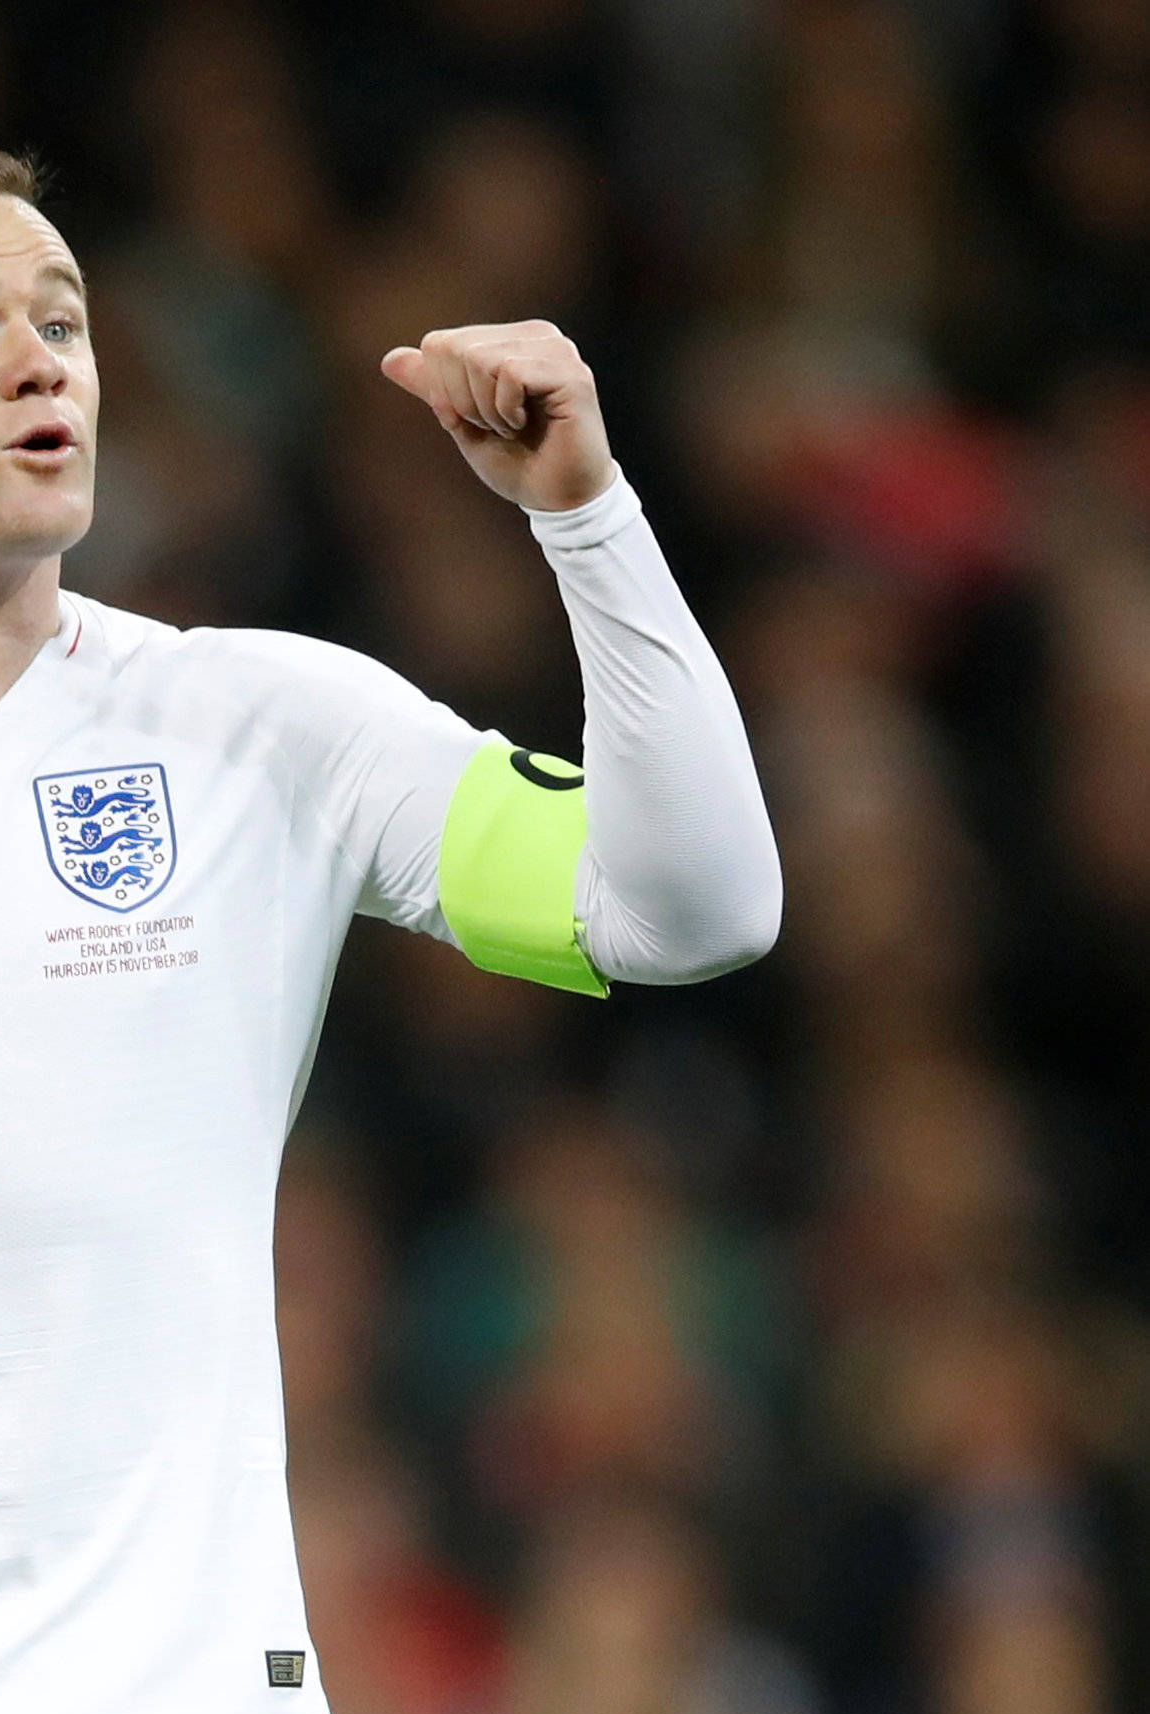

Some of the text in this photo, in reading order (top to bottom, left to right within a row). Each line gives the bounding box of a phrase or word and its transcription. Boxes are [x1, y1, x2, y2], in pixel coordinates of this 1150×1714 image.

[45, 915, 195, 943] WAYNE ROONEY FOUNDATION
[80, 941, 133, 958] ENGLAND
[146, 937, 167, 952] USA
[43, 950, 199, 979] THURSDAY 15 NOVEMBER 2018
